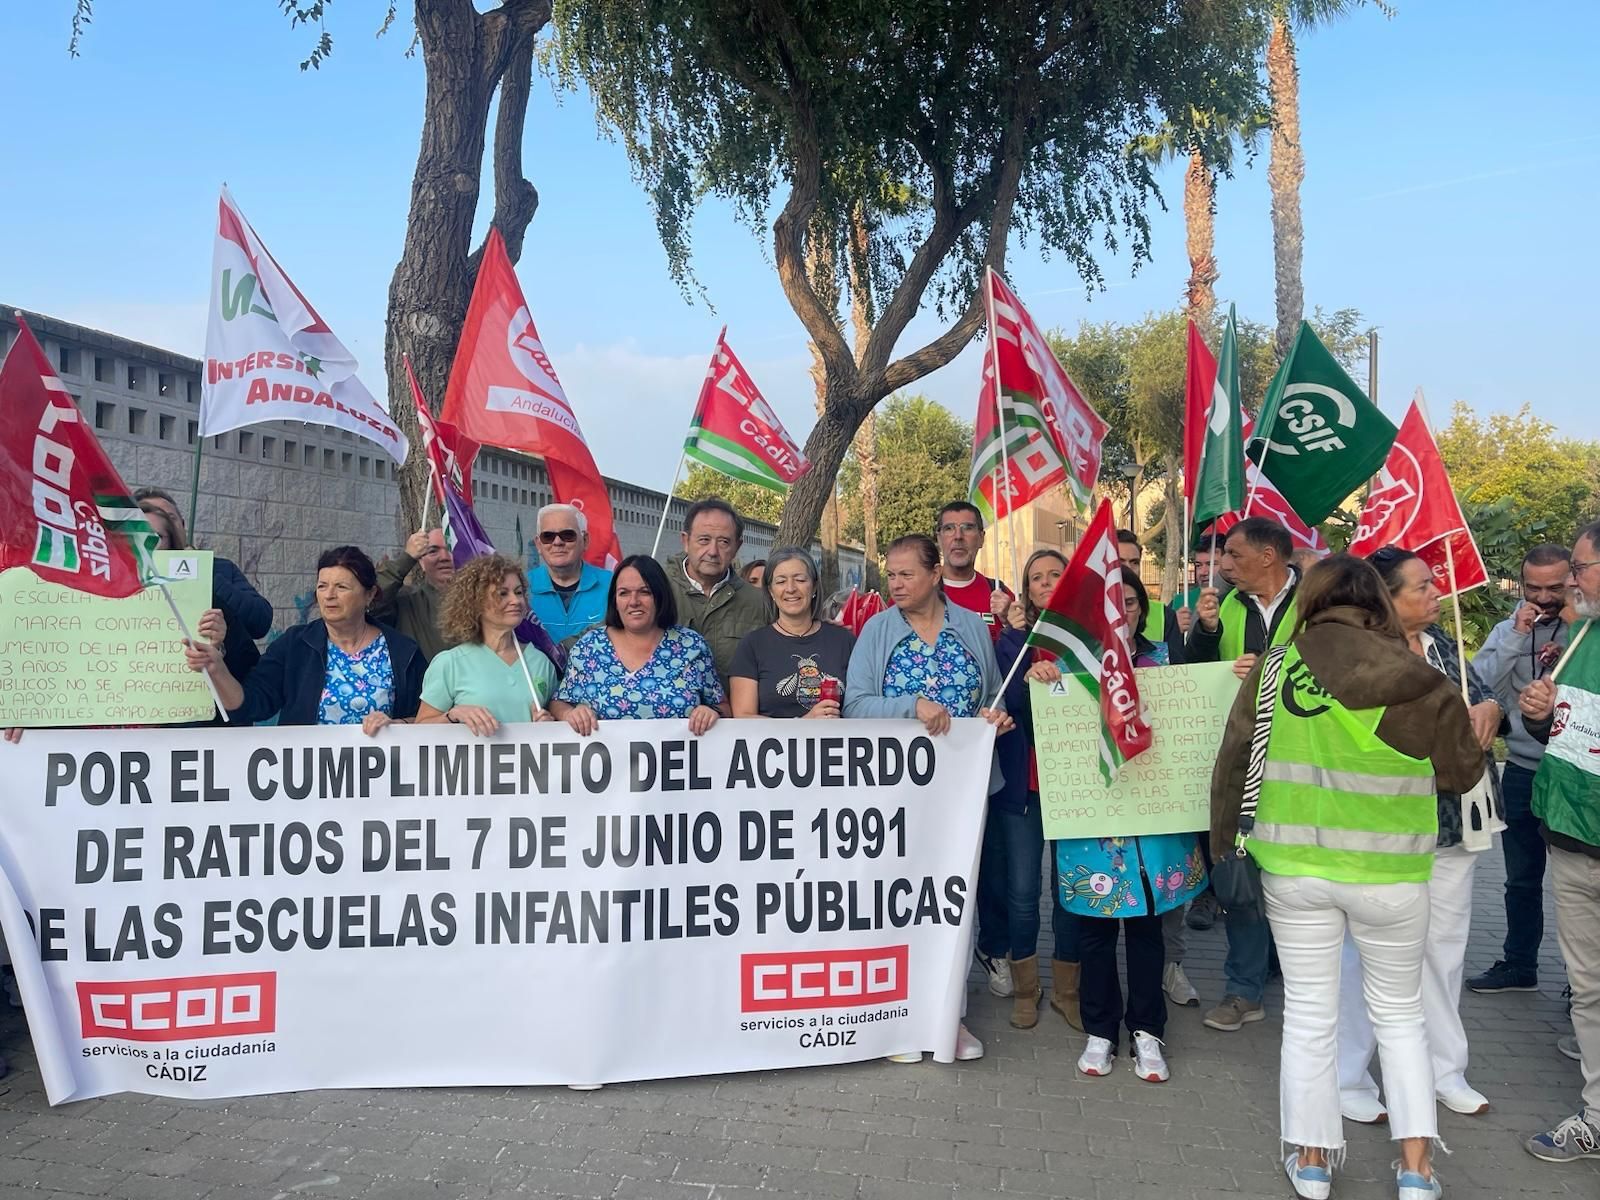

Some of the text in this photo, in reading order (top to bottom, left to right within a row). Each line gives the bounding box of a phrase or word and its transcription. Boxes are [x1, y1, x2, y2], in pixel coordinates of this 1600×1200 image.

[246, 377, 398, 443] ANDALUZA
[1279, 399, 1346, 452] CSIF
[740, 418, 797, 475] Cádiz
[14, 616, 81, 631] MAREA
[95, 617, 161, 631] CONTRA
[0, 640, 183, 655] UMENTO DE LA RATIO
[22, 660, 68, 673] AÑOS
[87, 660, 118, 673] LOS
[0, 677, 57, 691] BLICOS
[66, 678, 87, 691] NO
[95, 678, 112, 691] SE
[1138, 680, 1197, 697] ALIDAD
[12, 692, 68, 706] APOYO
[78, 693, 89, 704] A
[96, 692, 124, 704] LAS
[1101, 649, 1138, 743] Cádiz
[104, 706, 146, 719] CAMPO
[150, 707, 164, 719] DE
[1037, 695, 1217, 719] LA ESCU NFANTIL
[1041, 739, 1098, 754] AUMENT
[1173, 732, 1221, 747] RATIO
[1134, 751, 1163, 767] LOS
[45, 736, 935, 806] POR EL CUMPLIMIENTO DEL ACUERDO
[1047, 790, 1067, 804] EN
[1071, 788, 1123, 802] APOYO
[1048, 798, 1209, 821] CAMPO DE GIBRALTA
[75, 807, 906, 884] DE RATIOS DEL 7 DE JUNIO DE 1991
[23, 868, 967, 962] E LAS ESCUELAS INFANTILES PÚBLICAS
[753, 957, 897, 1001] CCOO
[90, 985, 261, 1029] CCOO
[740, 1016, 805, 1031] servicios
[809, 1017, 817, 1027] a
[822, 1014, 834, 1026] la
[82, 1039, 276, 1060] servicios a la ciudadanía
[799, 1029, 857, 1049] CÁDIZ
[146, 1062, 207, 1082] CÁDIZ
